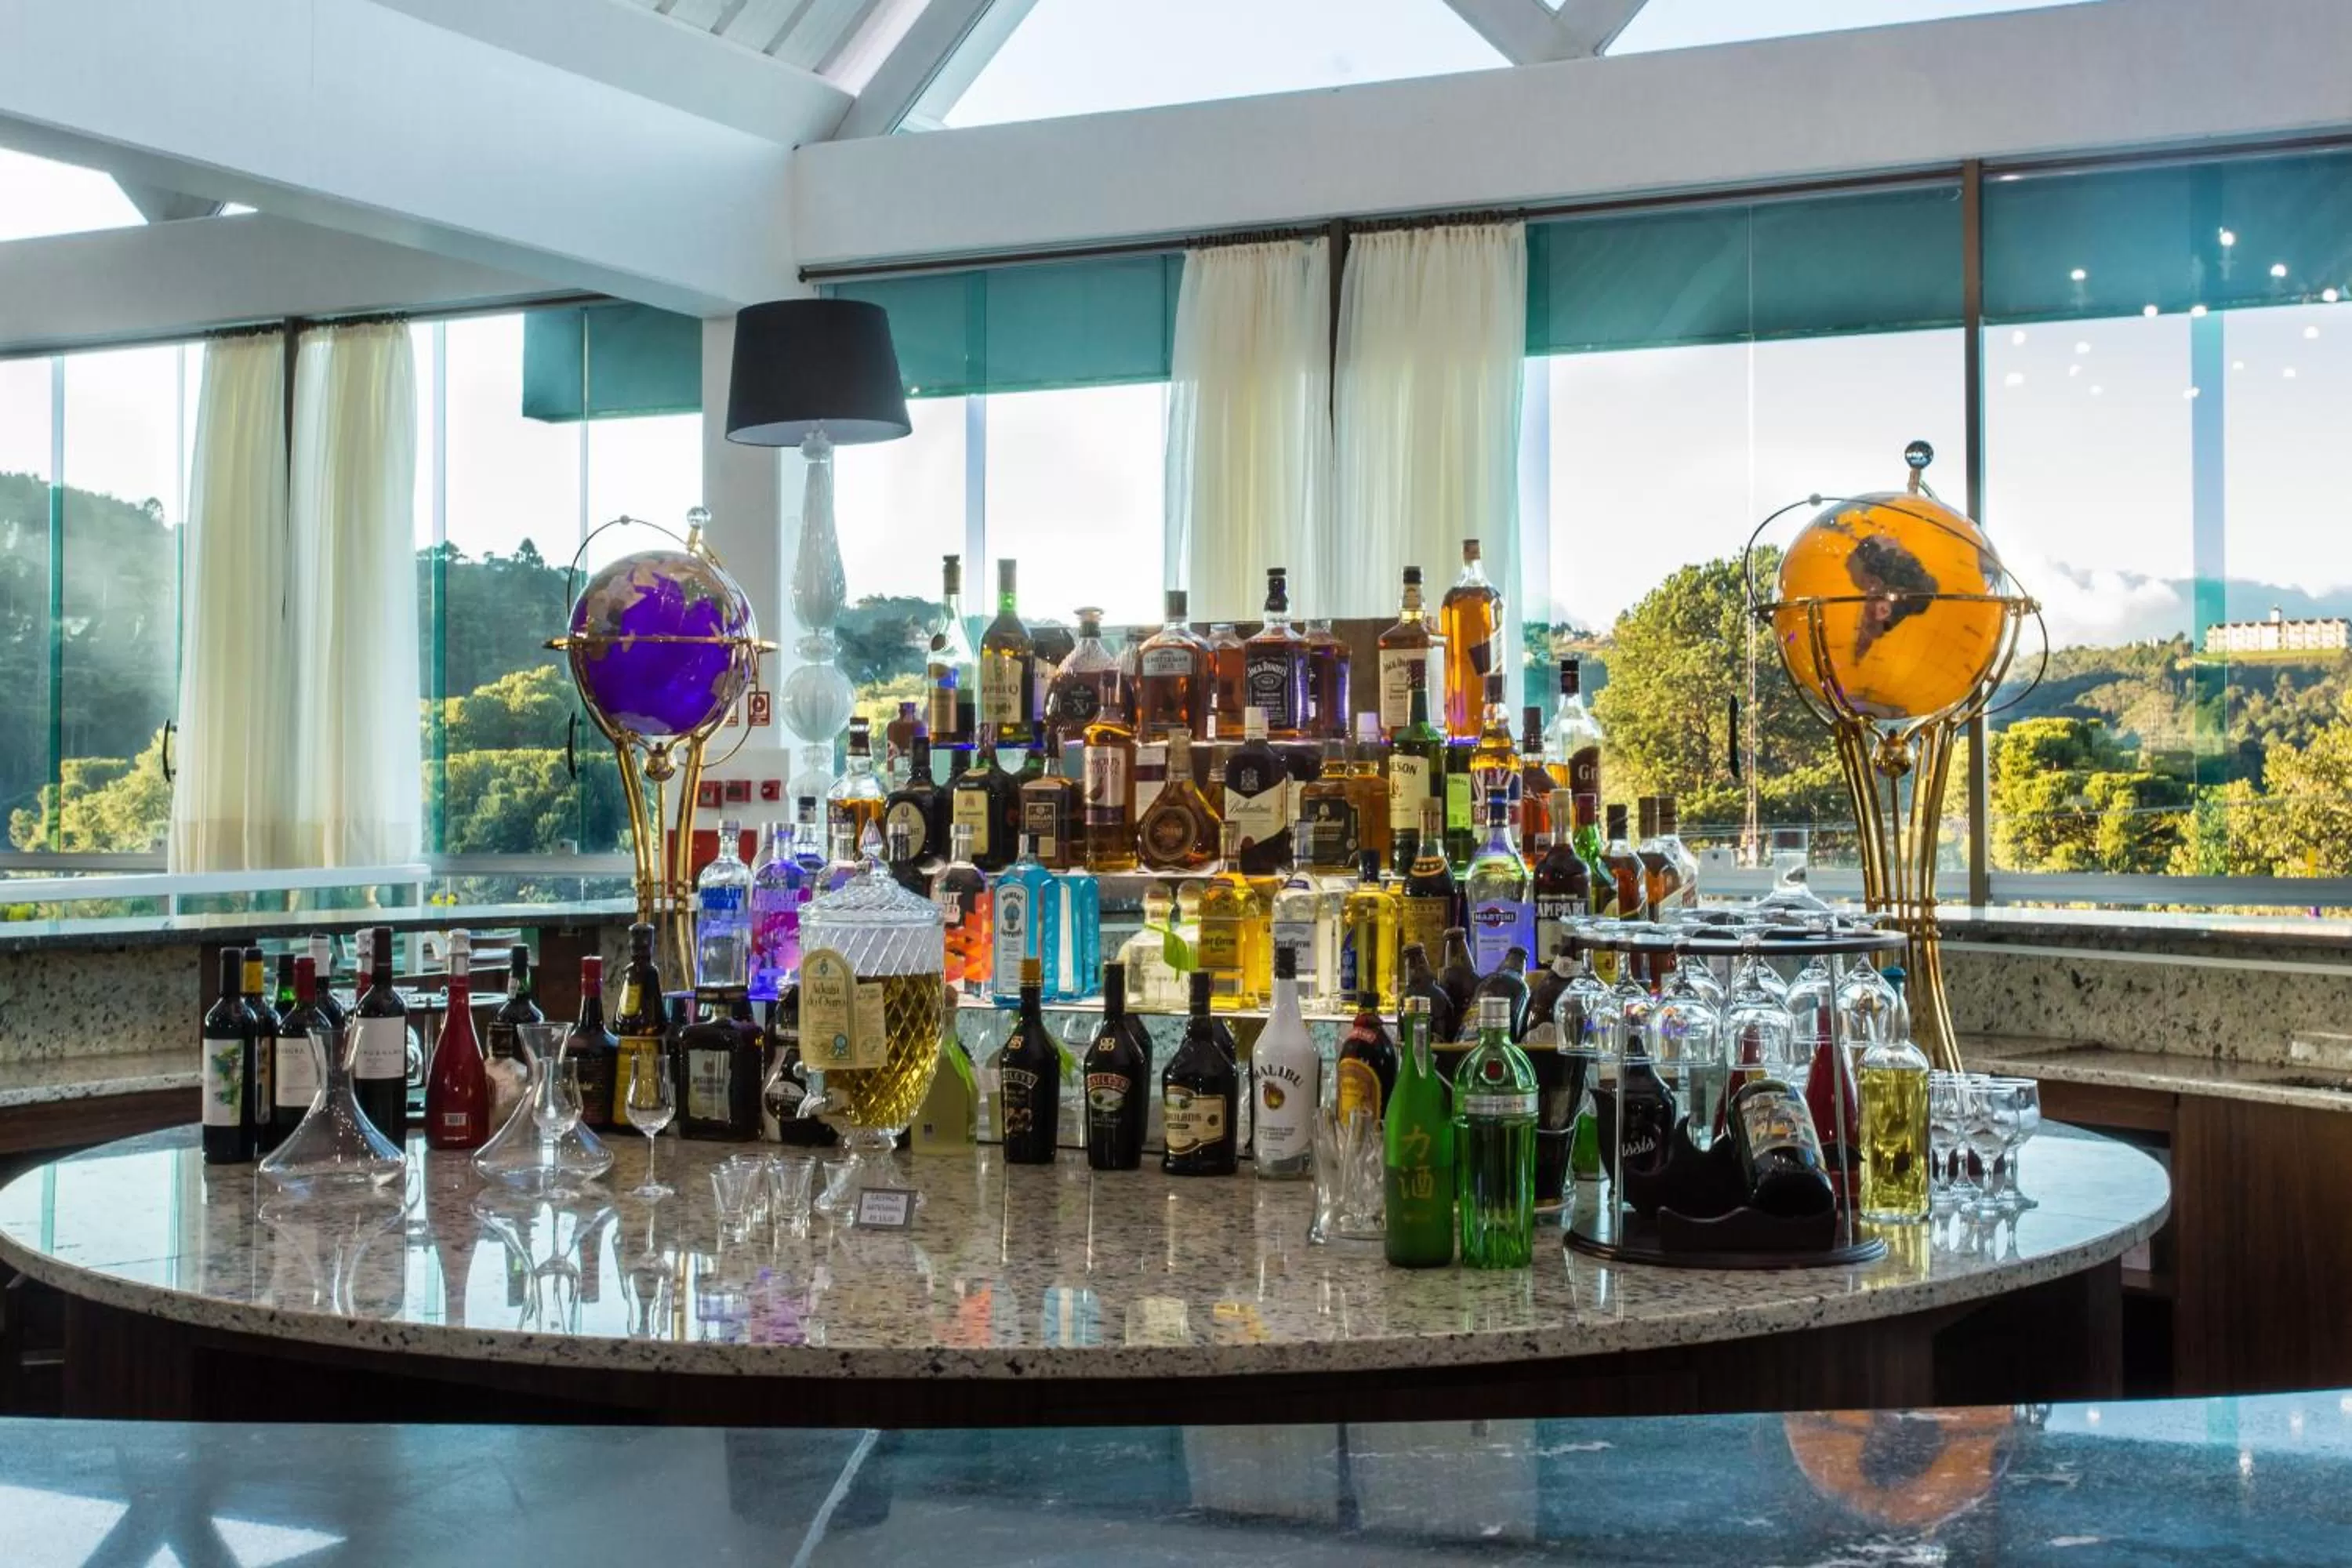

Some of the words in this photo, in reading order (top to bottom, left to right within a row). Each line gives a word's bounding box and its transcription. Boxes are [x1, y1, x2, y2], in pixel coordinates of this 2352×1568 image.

[1536, 902, 1585, 916] AMPARI
[1474, 913, 1514, 922] MARTINI
[1254, 1064, 1305, 1088] MALIBU
